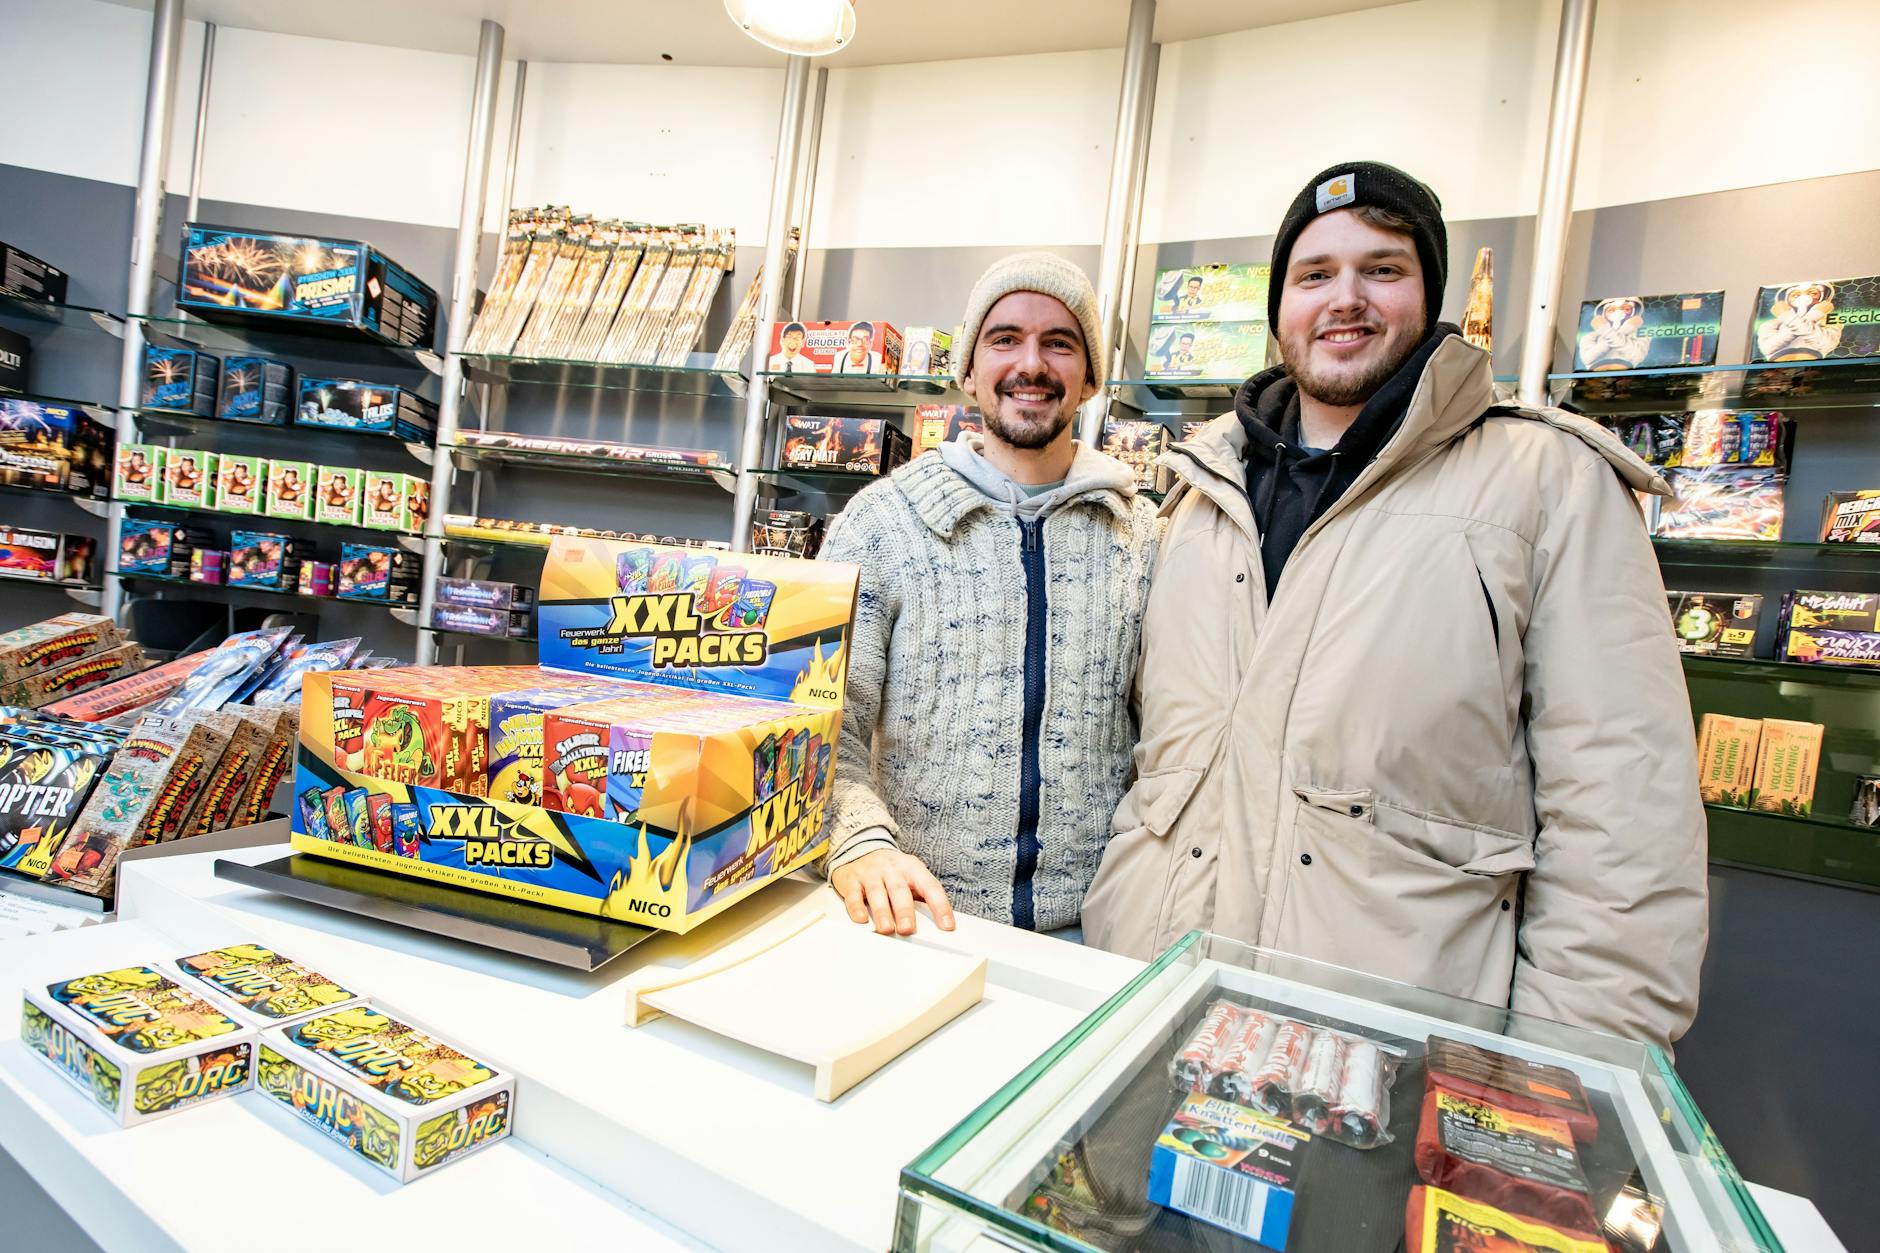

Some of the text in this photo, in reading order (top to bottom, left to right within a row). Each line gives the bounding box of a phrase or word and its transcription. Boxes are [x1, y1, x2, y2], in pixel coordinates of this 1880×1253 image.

[296, 274, 356, 302] PRISMA
[807, 339, 846, 347] BRUDER
[1636, 323, 1715, 338] Escaladas
[362, 403, 394, 420] TALOS
[1834, 512, 1865, 528] MIX
[608, 594, 698, 634] XXL
[1685, 608, 1712, 640] 3
[560, 628, 605, 638] Feuerwerk
[571, 637, 619, 647] das ganze
[600, 644, 623, 653] Jahr!
[654, 634, 764, 664] PACKS
[597, 663, 635, 674] beliebtesten
[638, 669, 684, 681] Jugend-Artikel
[376, 694, 426, 707] Jugendfeuerwerk
[808, 688, 838, 700] NICO
[338, 727, 361, 741] PACK
[559, 717, 610, 729] Jugendfeuerwerk
[477, 733, 485, 757] PACK
[446, 751, 455, 777] XXL
[472, 746, 480, 773] XXL
[573, 758, 598, 774] XXL
[1711, 739, 1727, 781] VOLCANIC
[1723, 738, 1741, 784] LIGHTNING
[1770, 746, 1786, 791] VOLCANIC
[1784, 745, 1800, 793] LIGHTNING
[429, 806, 500, 837] XXL
[746, 781, 801, 857] XXL
[771, 804, 824, 874] PACKS
[26, 858, 48, 870] NICO
[466, 841, 550, 865] PACKS
[327, 845, 544, 897] Die beliebtesten Jugend-Artikel im großen XXL-Pack!
[703, 856, 744, 890] Feuerwerk
[713, 861, 754, 895] das ganze
[628, 898, 671, 918] NICO
[217, 965, 284, 996] ORC
[84, 993, 162, 1026] ORC
[333, 1039, 414, 1075] ORC
[175, 1059, 246, 1098] ORC
[302, 1071, 355, 1128] ORC
[1205, 1099, 1240, 1117] Blitz
[447, 1108, 505, 1151] ORC
[1258, 1147, 1270, 1158] 9
[1445, 1212, 1497, 1237] NICO
